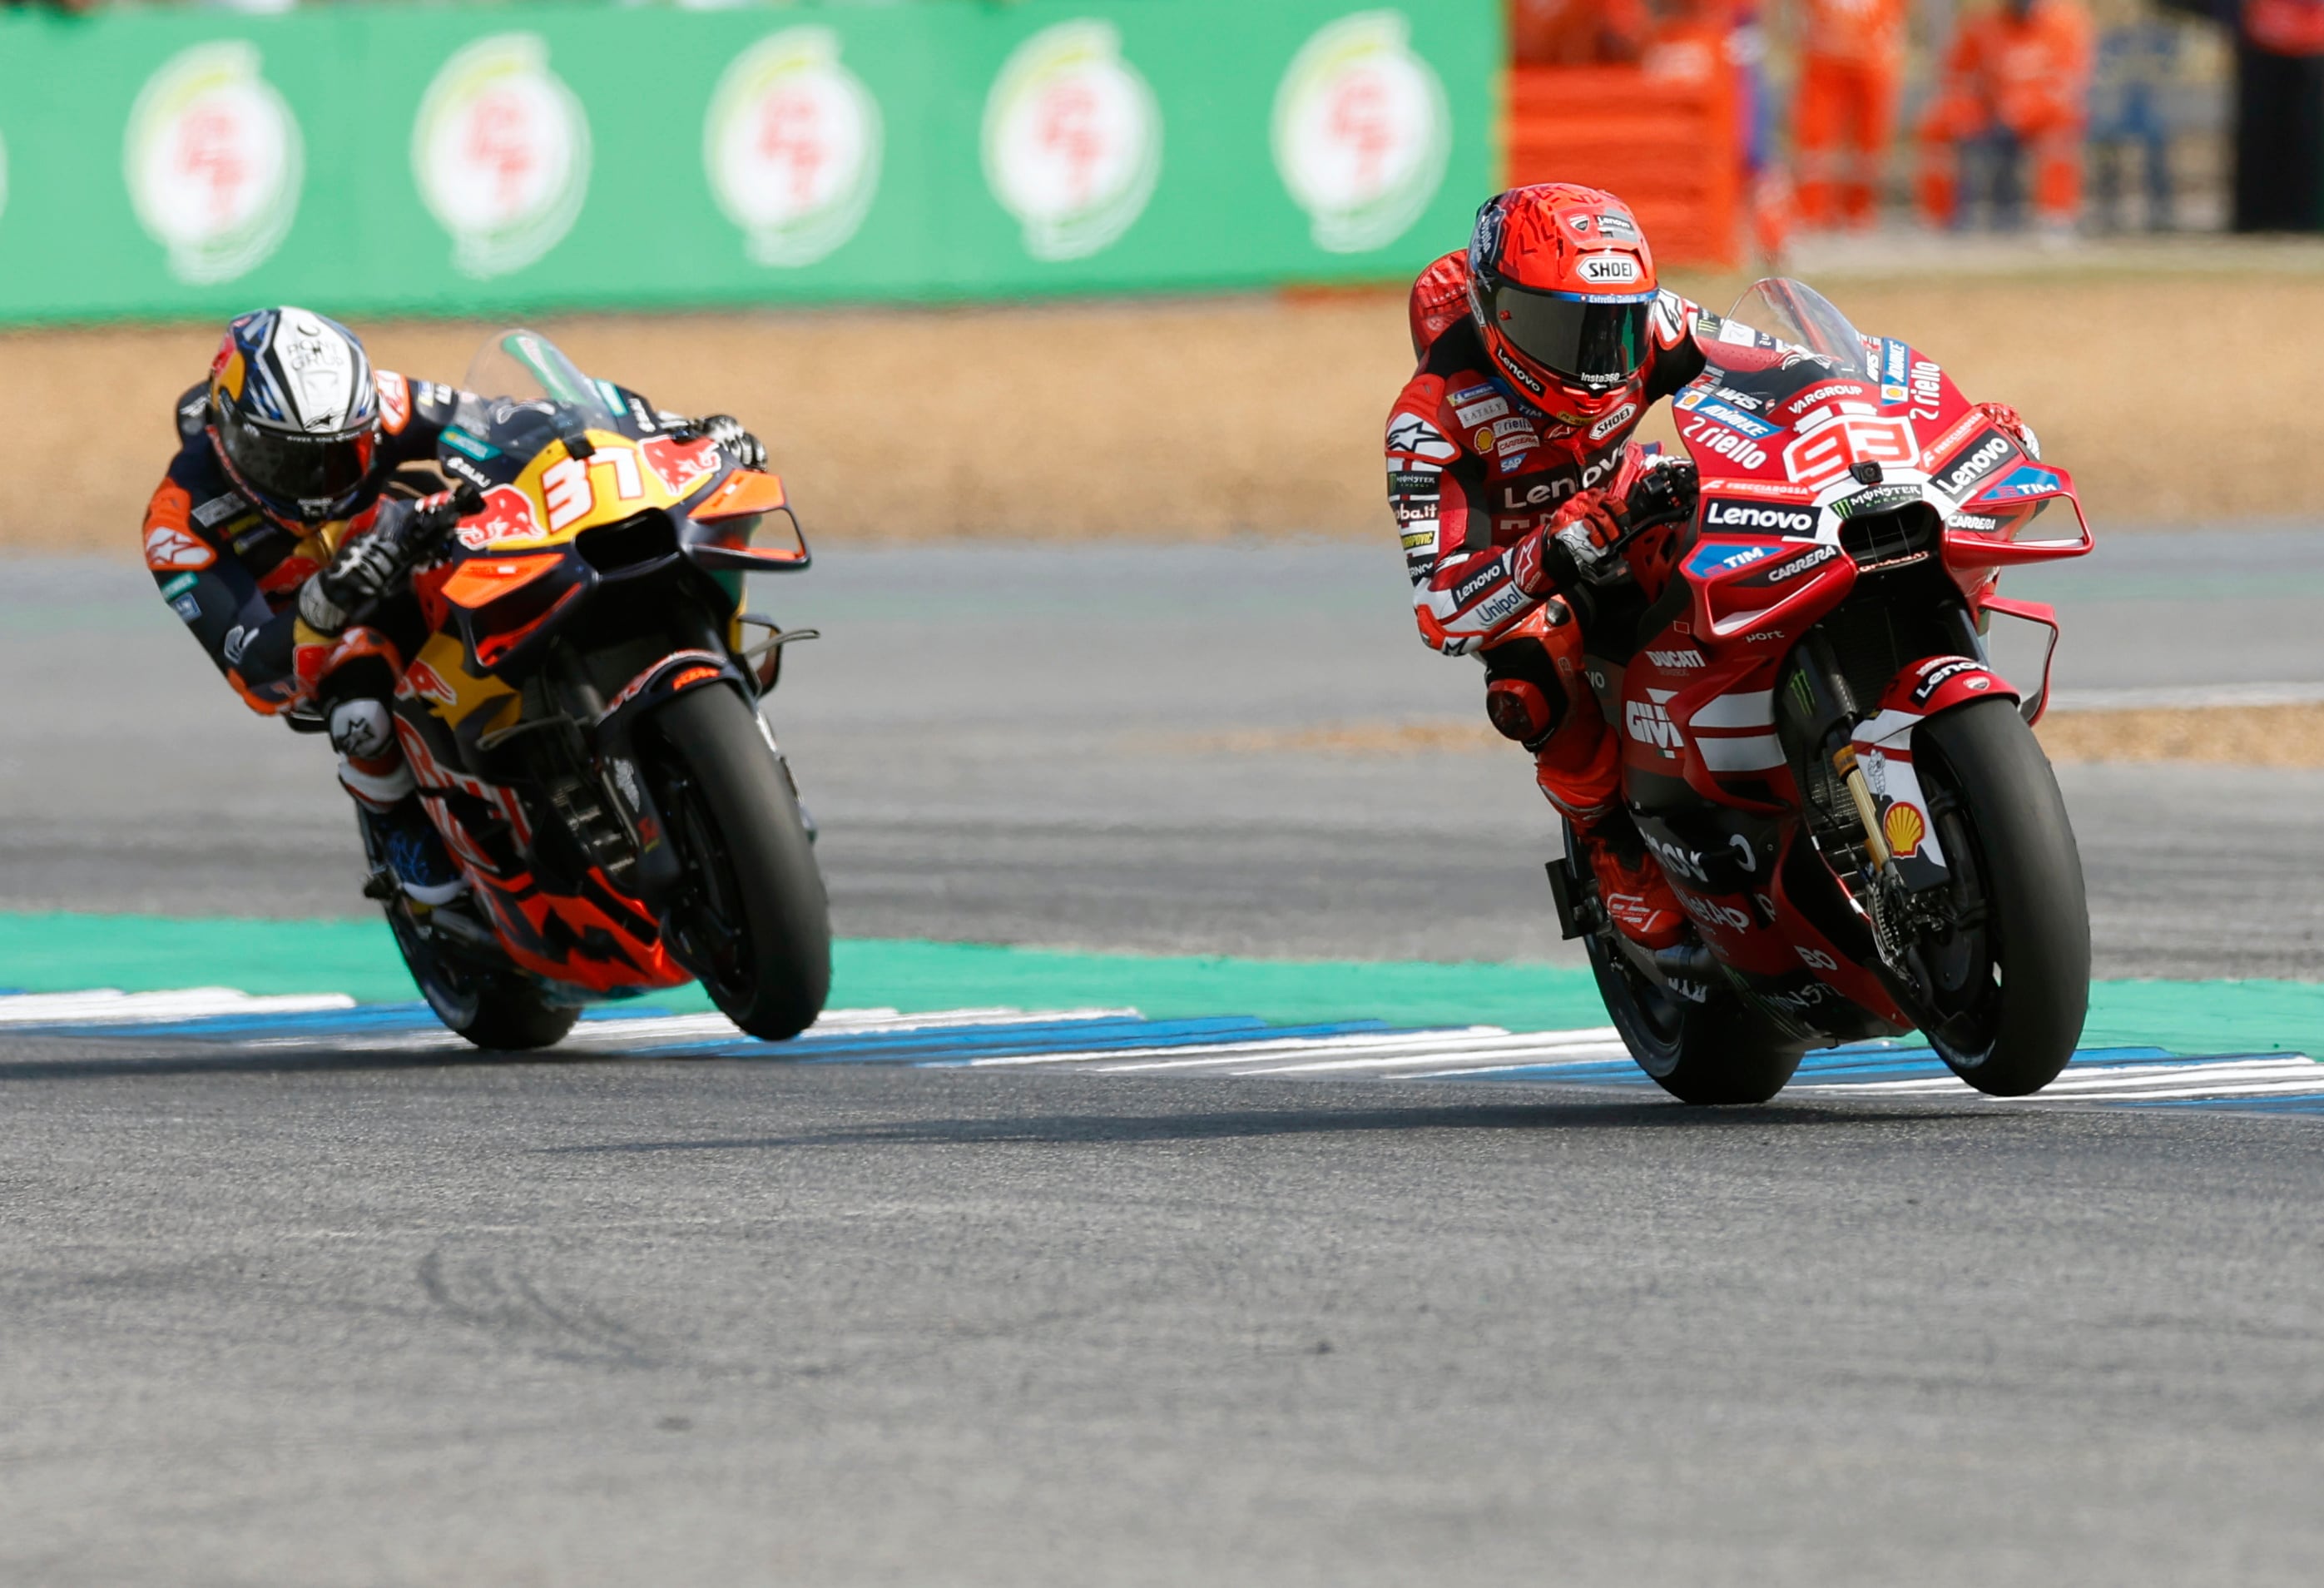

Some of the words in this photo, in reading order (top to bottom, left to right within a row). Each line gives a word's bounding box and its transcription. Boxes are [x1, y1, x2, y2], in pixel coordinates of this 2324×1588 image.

[1588, 262, 1633, 277] SHOEI
[1498, 348, 1541, 392] Lenovo
[1581, 372, 1620, 382] Insta360
[1910, 360, 1940, 406] riello
[1518, 404, 1543, 418] TIM
[1597, 408, 1631, 435] SHOEI
[1696, 426, 1767, 469] riello
[1500, 457, 1523, 472] SAP
[1936, 437, 2009, 494] Lenovo
[541, 446, 645, 535] 37
[1850, 485, 1921, 506] MONSTER
[2017, 484, 2057, 496] TIM
[1707, 502, 1812, 531] Lenovo
[1948, 515, 1996, 530] CARRERA
[1723, 547, 1765, 568] TIM
[1768, 544, 1836, 582] CARRERA
[1456, 564, 1500, 603] Lenovo
[1475, 584, 1523, 623] Unipol
[1645, 649, 1706, 667] DUCATI
